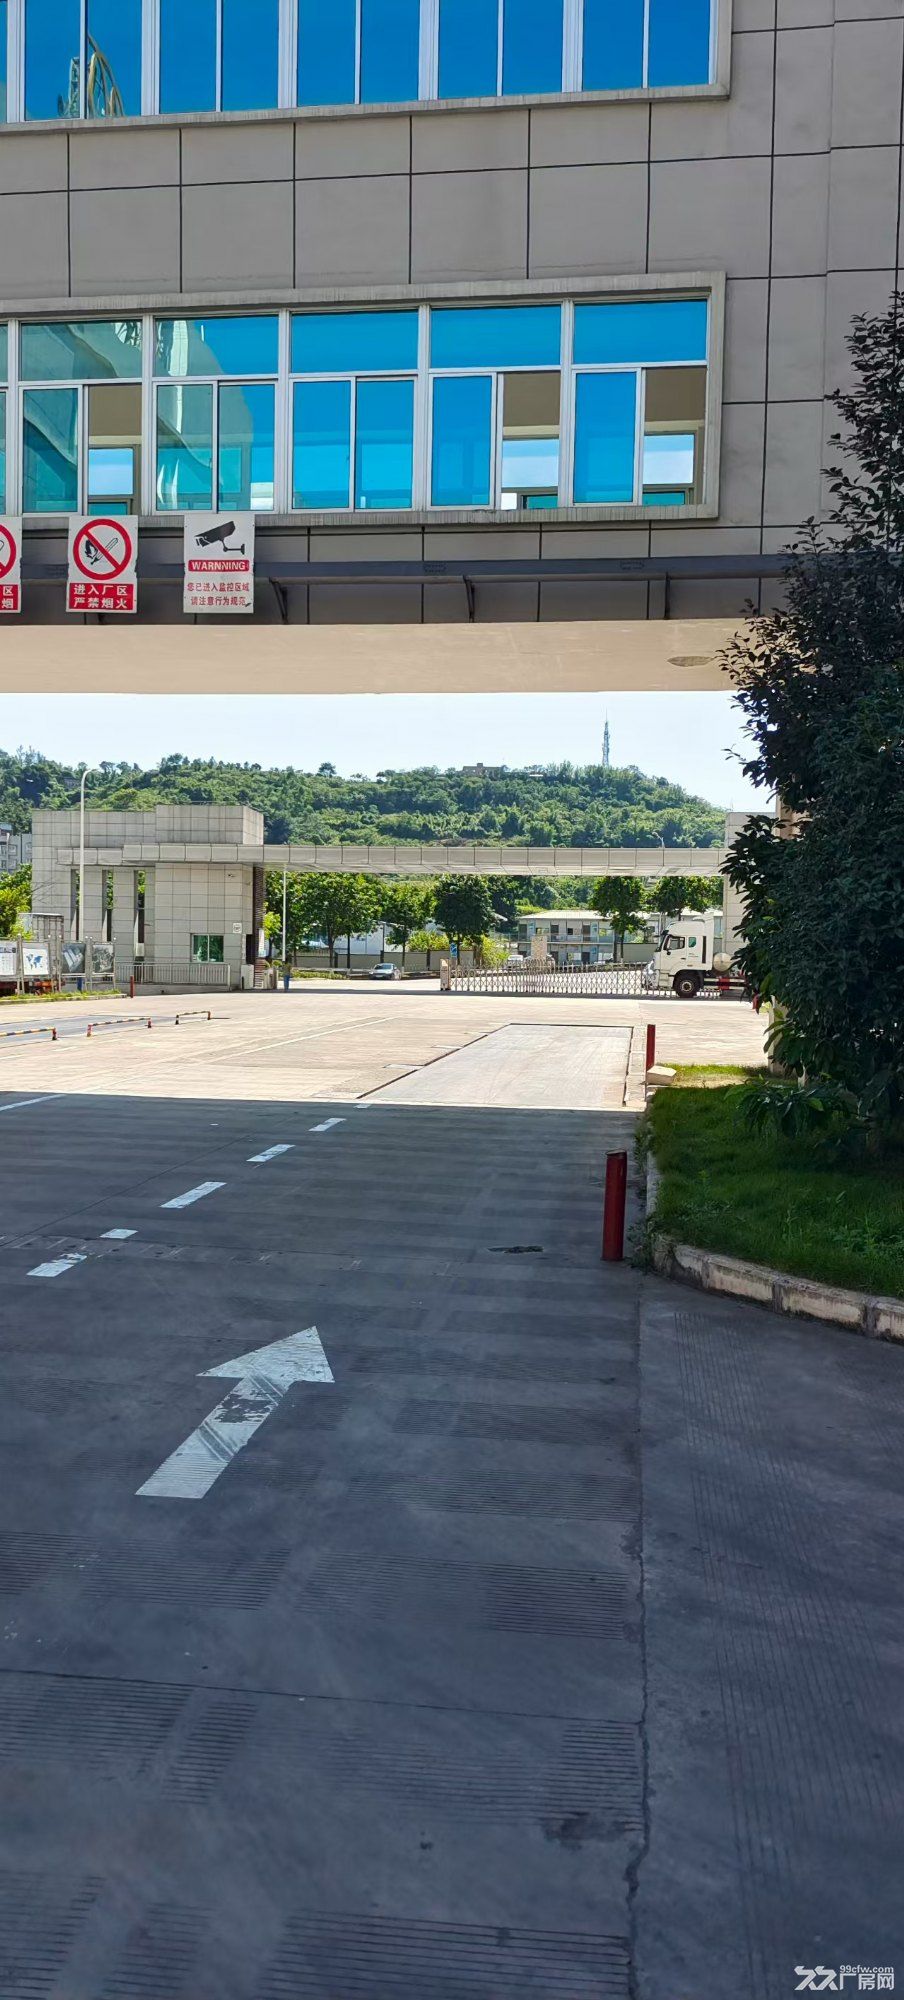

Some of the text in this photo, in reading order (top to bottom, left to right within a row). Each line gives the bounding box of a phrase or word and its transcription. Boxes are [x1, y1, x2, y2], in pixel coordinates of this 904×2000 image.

[192, 561, 246, 570] WARNNING
[74, 584, 128, 596] 进入厂区
[187, 582, 250, 592] 您已进入监控区域
[74, 597, 128, 609] 严禁烟火
[191, 596, 247, 606] 请注意行为规范
